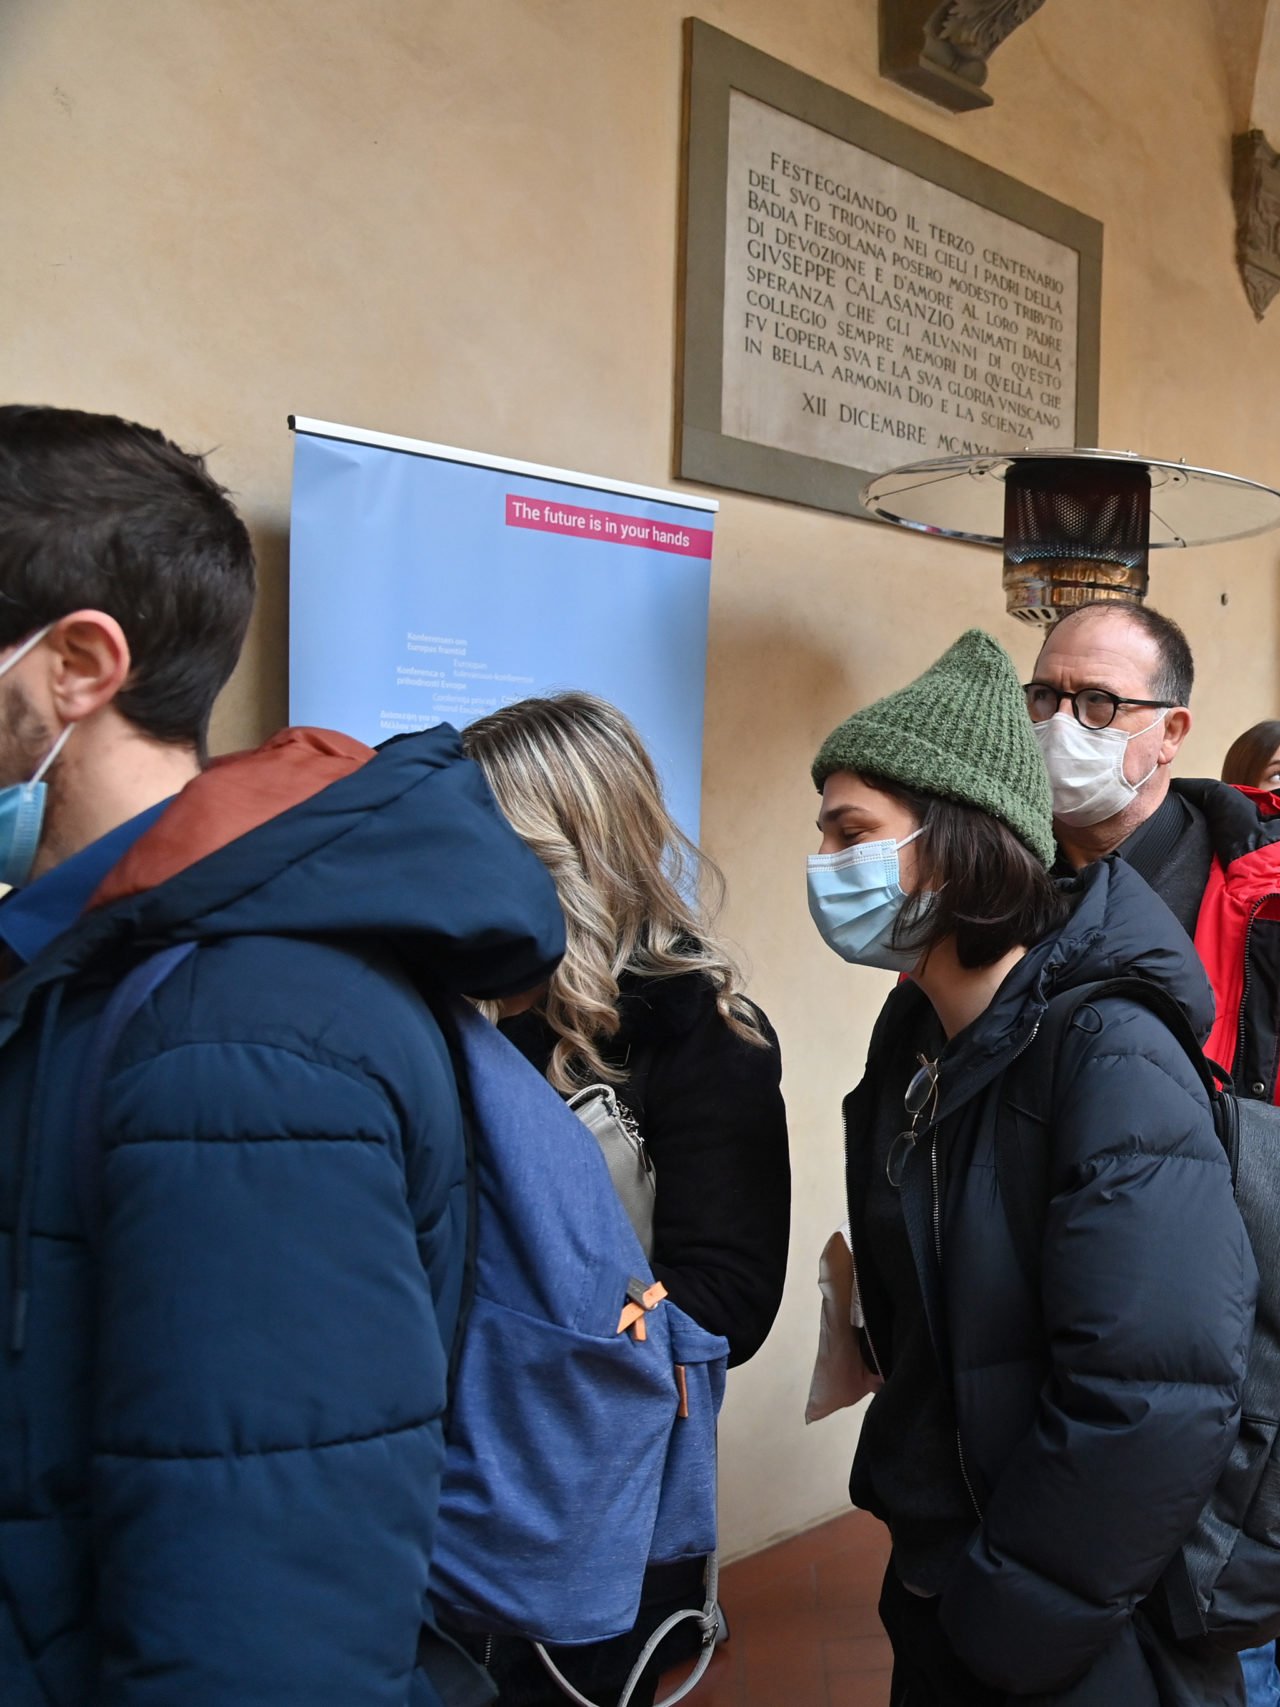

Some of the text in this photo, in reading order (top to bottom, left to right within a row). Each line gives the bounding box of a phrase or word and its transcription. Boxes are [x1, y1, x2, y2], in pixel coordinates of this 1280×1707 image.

[747, 190, 798, 228] BADIA
[803, 213, 887, 263] FIESOLANA
[892, 251, 943, 284] POSERO
[949, 276, 1009, 311] MODESTO
[748, 168, 1063, 315] DEL SVO TRIONFO NEI CIELI I PADRI DELLA
[770, 151, 1065, 295] FESTEGGIANDO IL TERZO CENTENARIO
[746, 265, 1062, 390] SPERANZA CHE GLI ALVNNI DI QVESTO
[747, 216, 1062, 353] DI DEVOZIONE E D'AMORE AL LORO PADRE
[747, 238, 1062, 373] GIVSEPPE CALASANZIO ANIMATI DALLA
[744, 336, 1034, 441] IN BELLA ARMONIA DIO E LA SCIENZA
[745, 312, 768, 333] FV
[774, 321, 838, 358] L'OPERA
[843, 345, 872, 369] SVA
[876, 355, 886, 373] E
[891, 360, 911, 382] LA
[916, 369, 943, 392] SVA
[947, 380, 995, 409] GLORIA
[746, 289, 1062, 410] COLLEGIO SEMPRE MEMORI DI QVELLA CHE
[801, 392, 828, 418] XII
[839, 402, 927, 446] DICEMBRE
[512, 501, 691, 548] The future is in your hands
